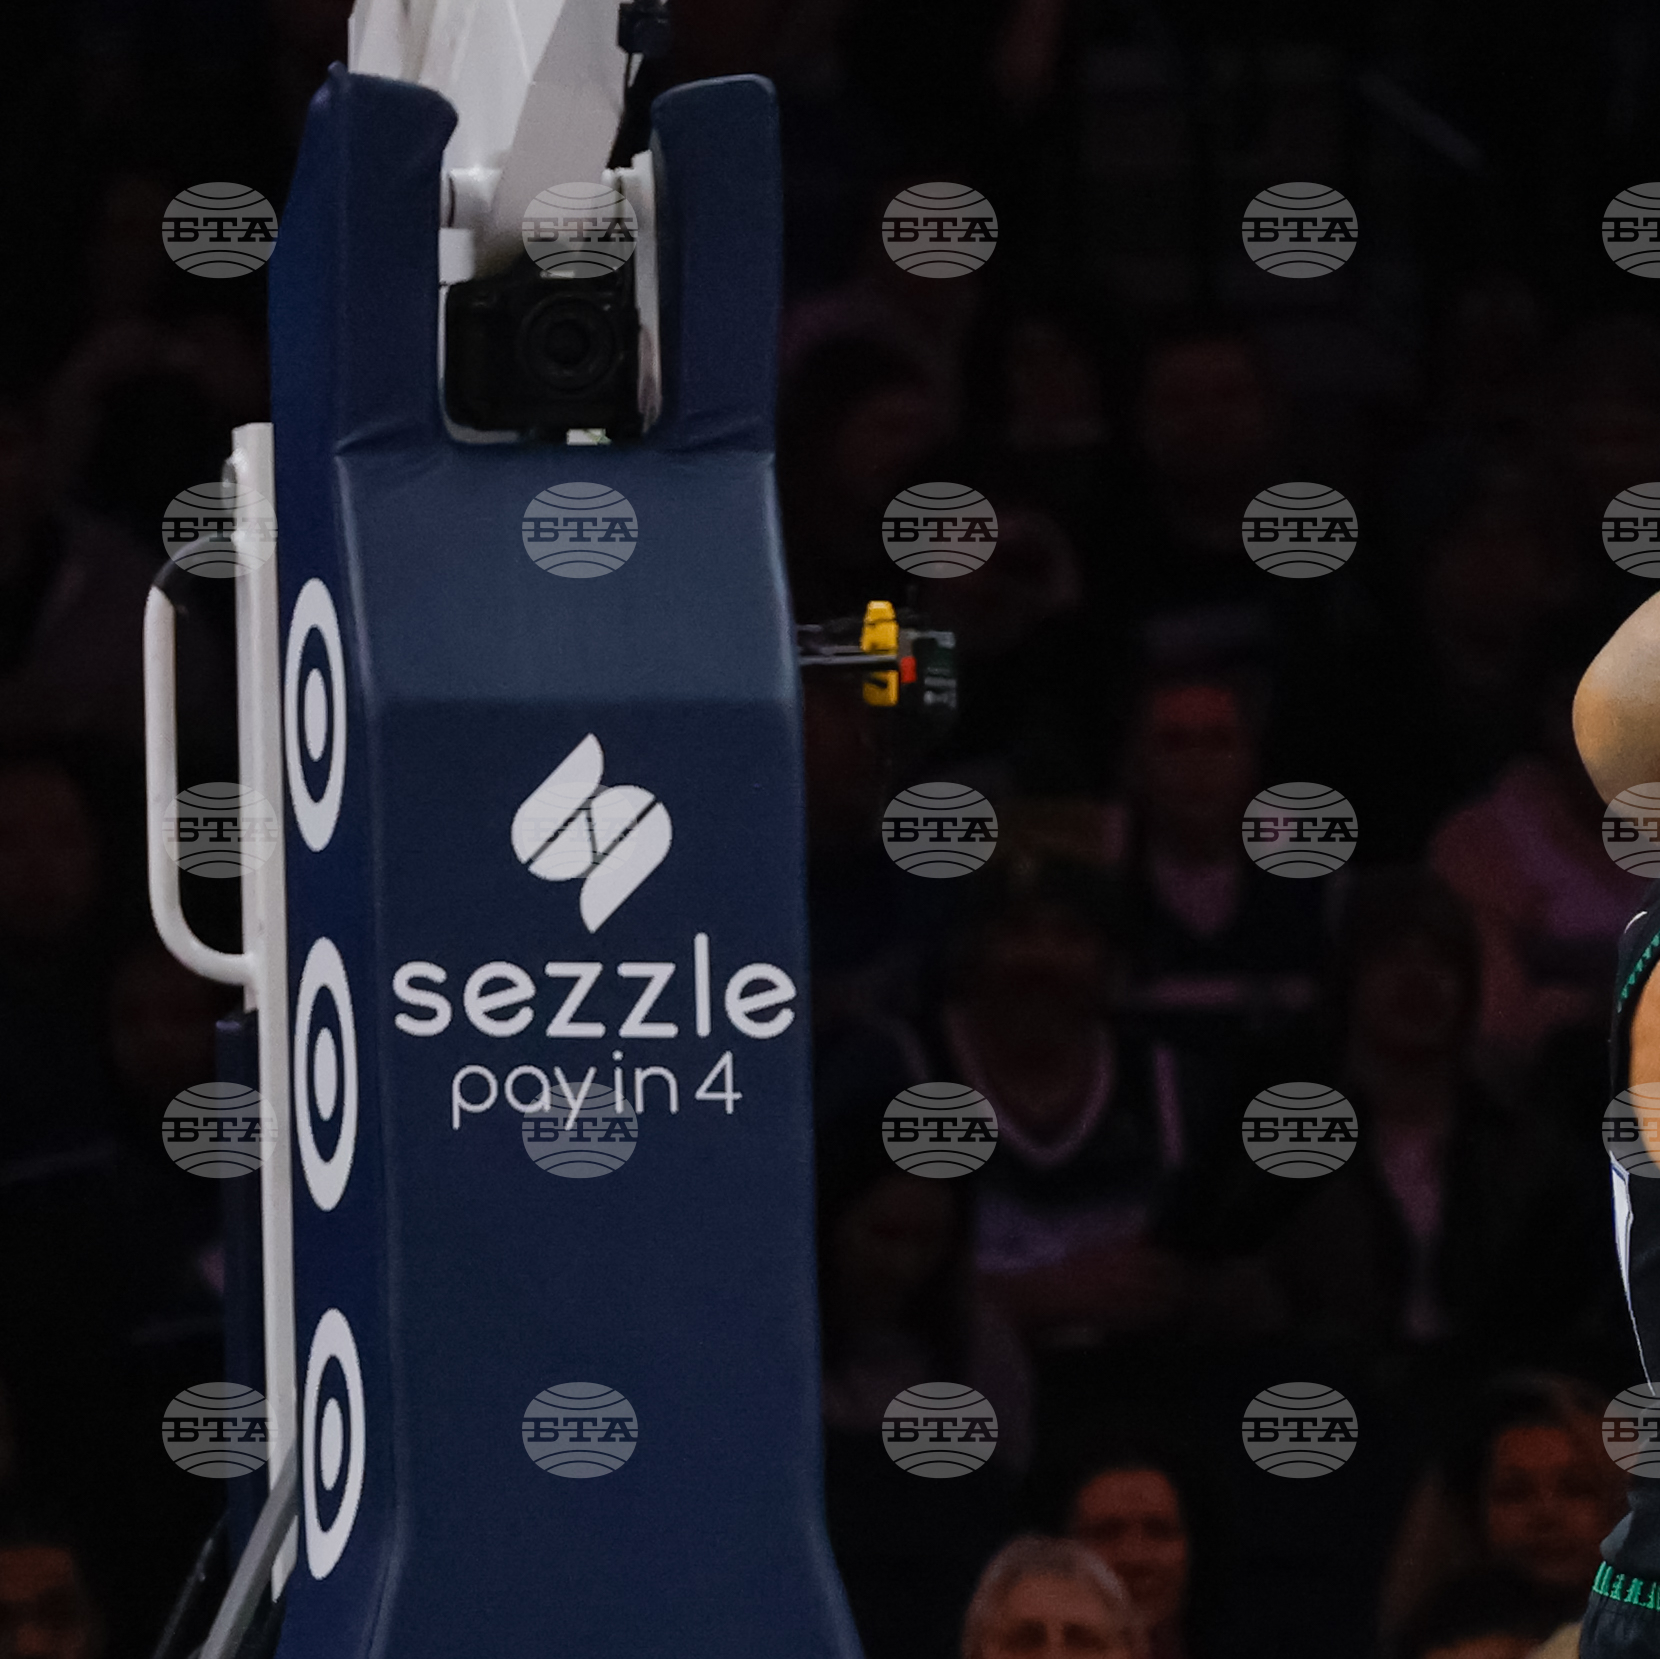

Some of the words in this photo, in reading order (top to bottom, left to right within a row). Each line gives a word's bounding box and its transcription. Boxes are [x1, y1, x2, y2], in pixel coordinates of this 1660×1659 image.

[392, 932, 798, 1040] sezzle
[452, 1064, 598, 1131] pay
[694, 1051, 743, 1115] 4
